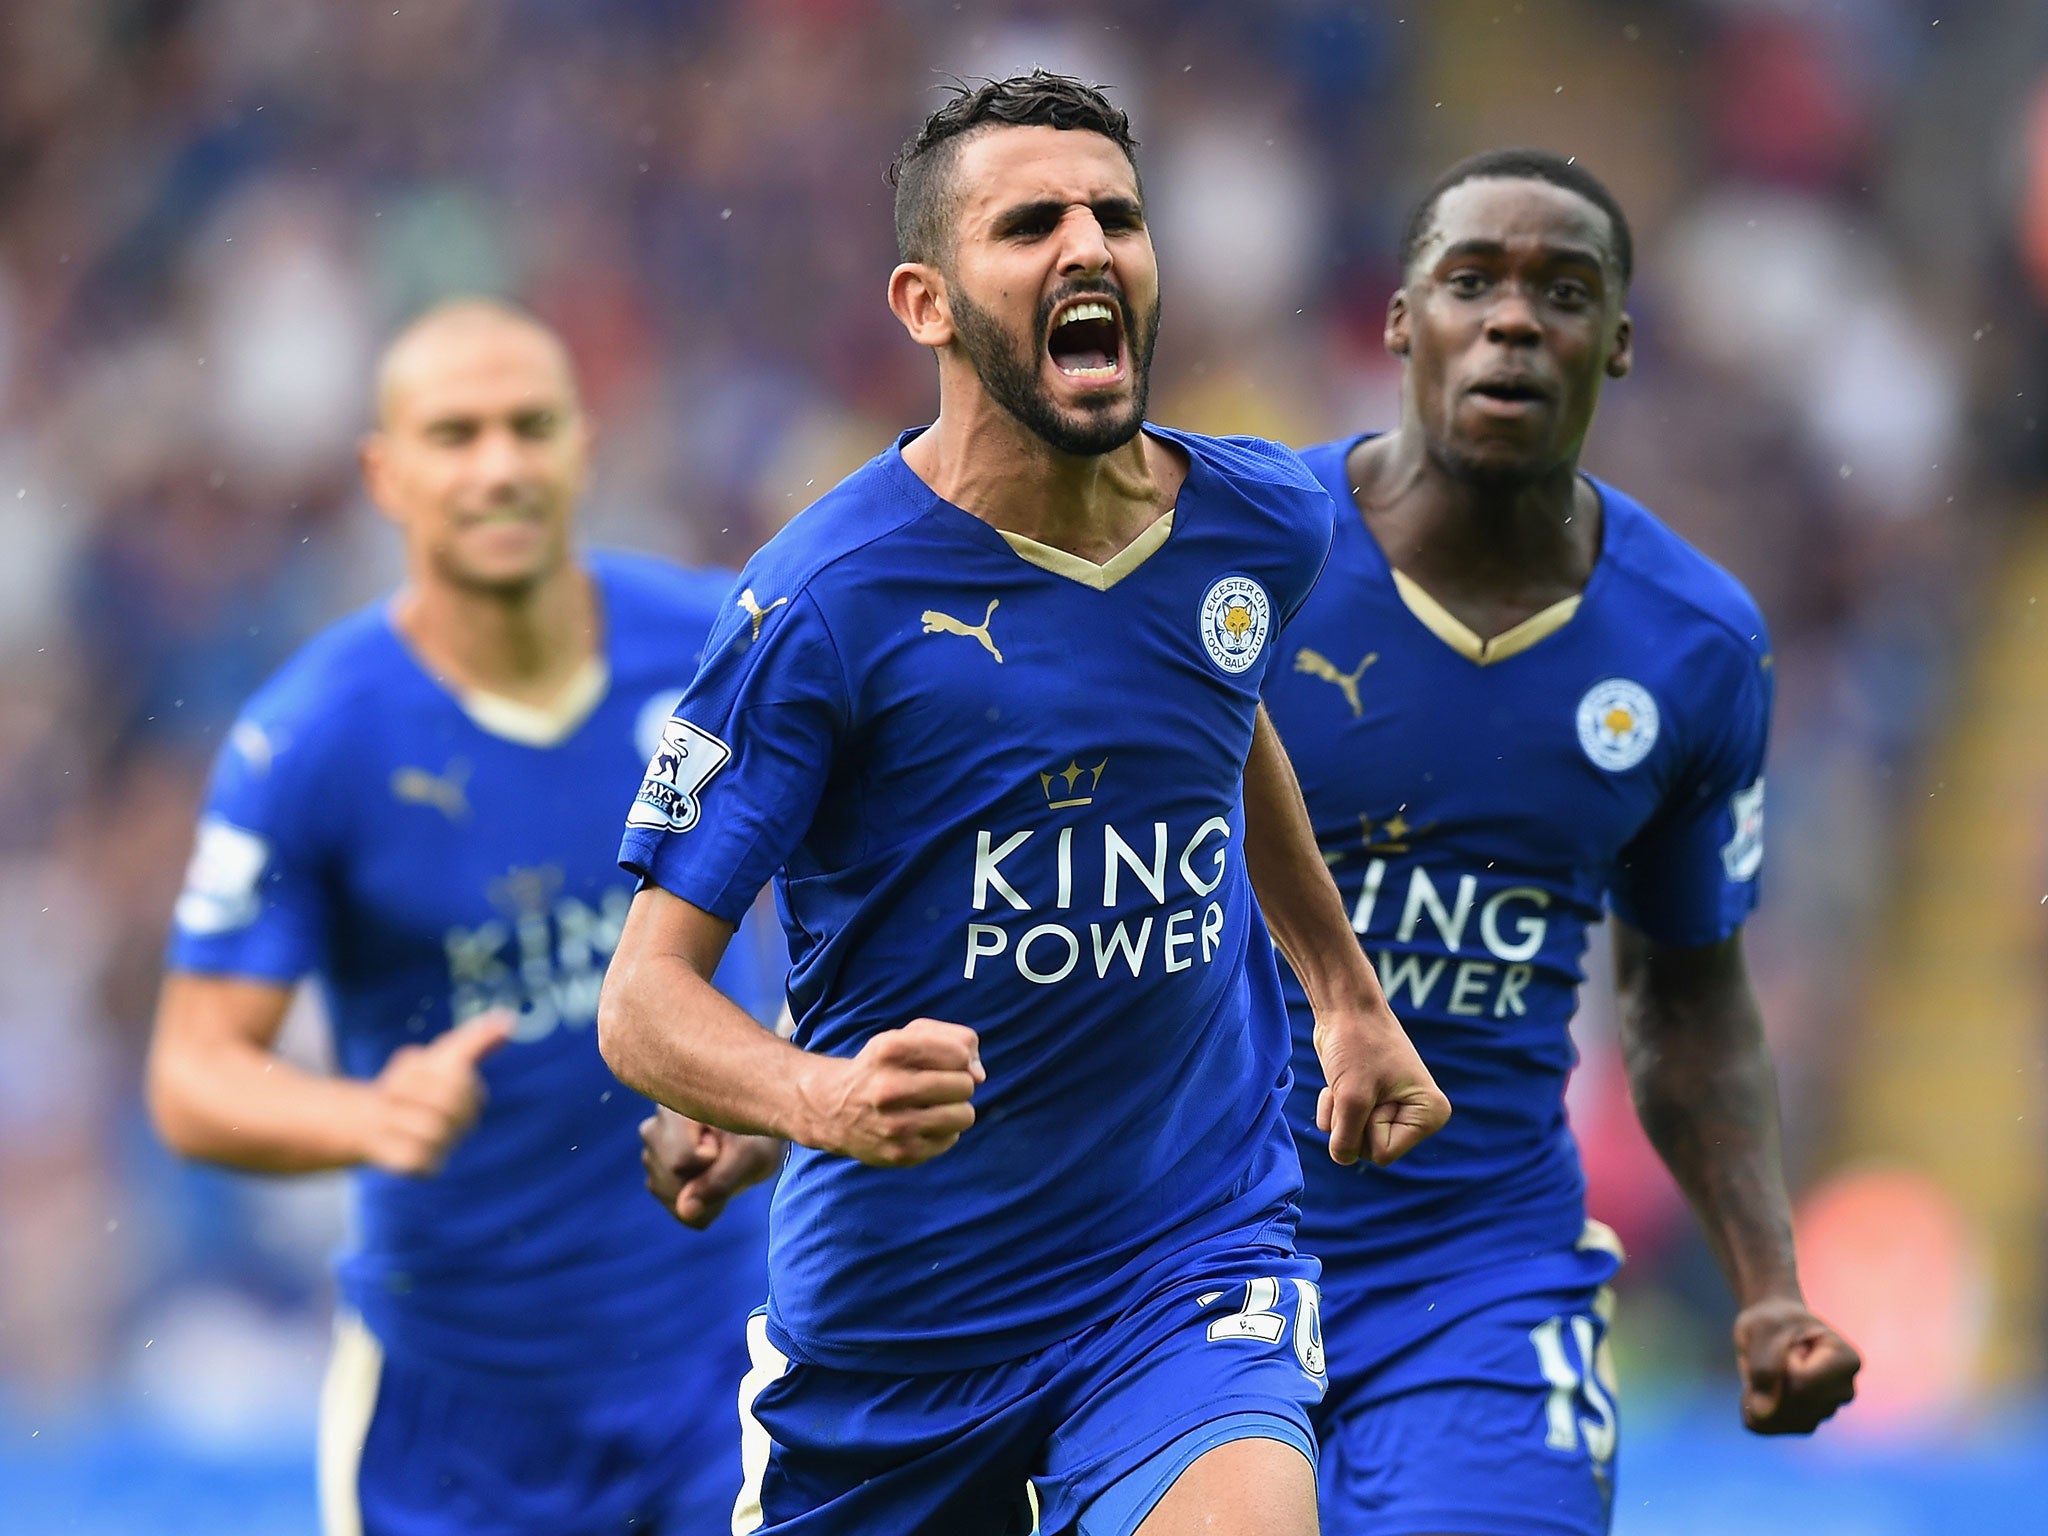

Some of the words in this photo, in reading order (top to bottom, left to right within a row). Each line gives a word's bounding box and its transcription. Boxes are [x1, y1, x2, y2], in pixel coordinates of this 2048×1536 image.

[1204, 581, 1254, 620] LEICESTER
[1254, 591, 1267, 619] CITY
[1205, 629, 1248, 668] FOOTBALL
[639, 780, 675, 803] LAYS
[972, 816, 1231, 910] KING
[1323, 852, 1550, 962] ING
[963, 901, 1224, 984] POWER
[1377, 949, 1532, 1018] WER
